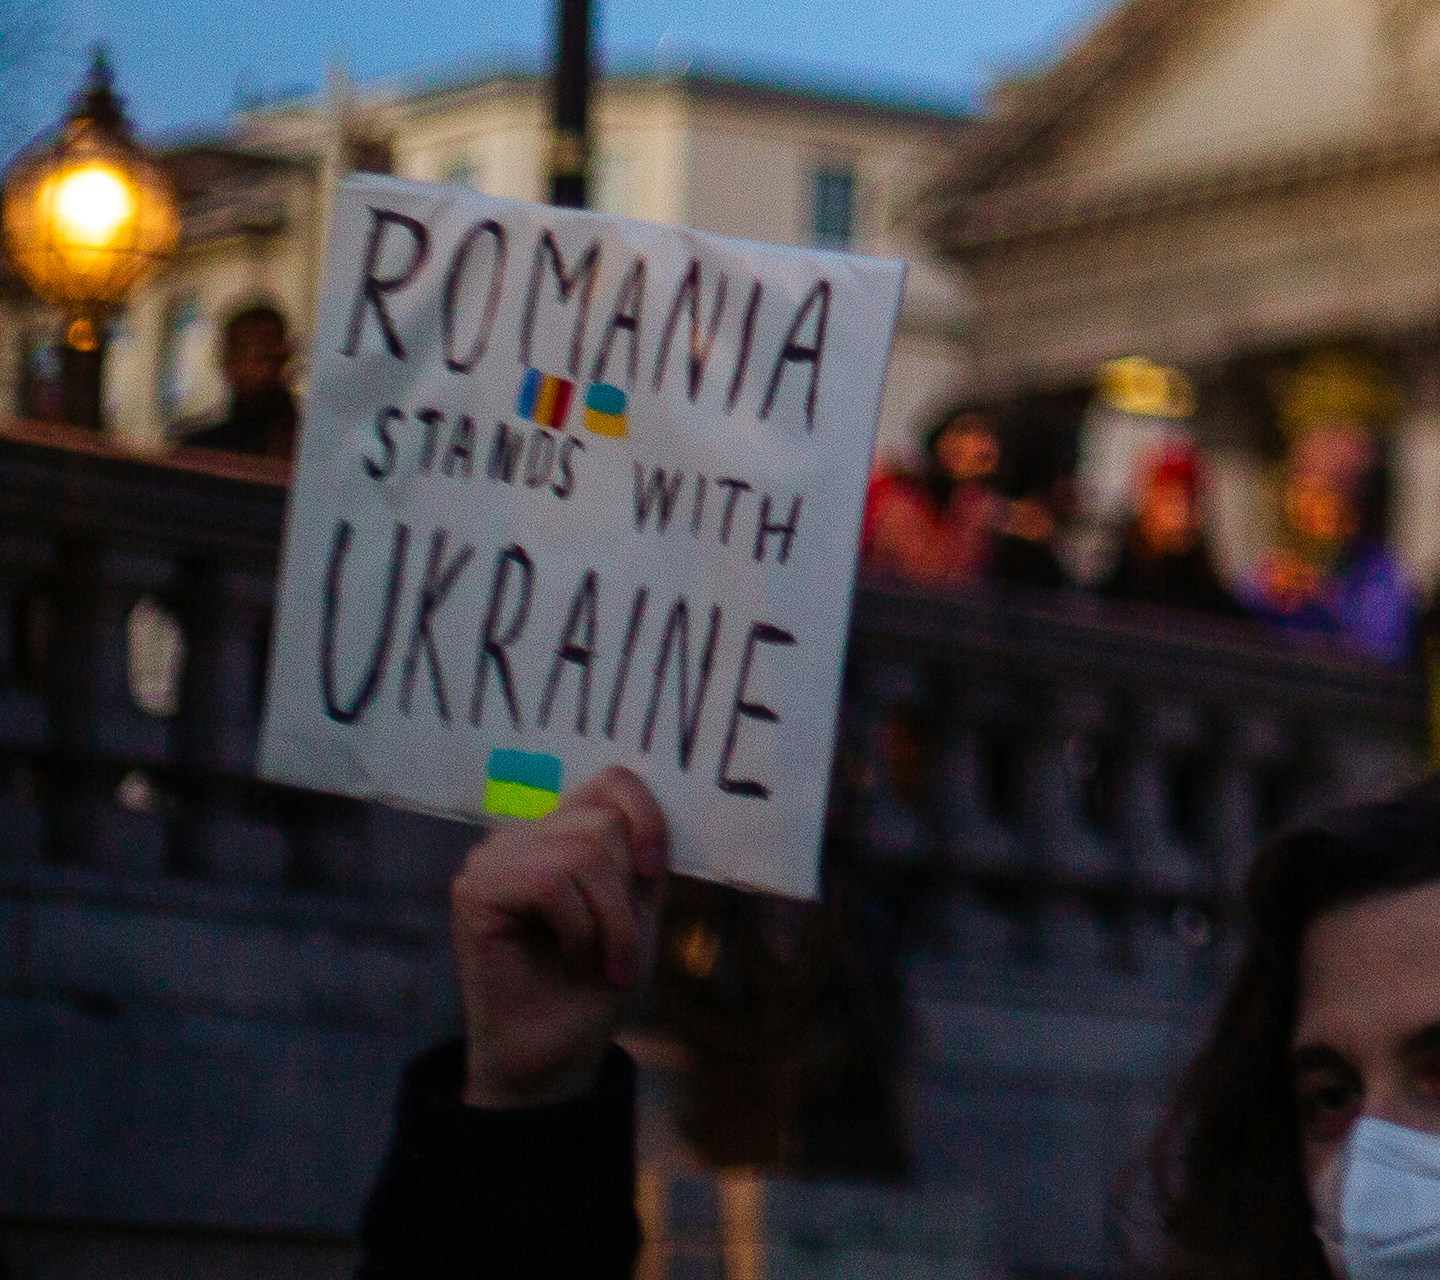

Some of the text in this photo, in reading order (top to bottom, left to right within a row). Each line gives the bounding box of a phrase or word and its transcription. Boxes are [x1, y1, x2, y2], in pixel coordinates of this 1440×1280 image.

[339, 206, 833, 436] ROMANIA
[363, 406, 803, 565] STANDS WITH
[320, 518, 797, 802] UKRAINE
